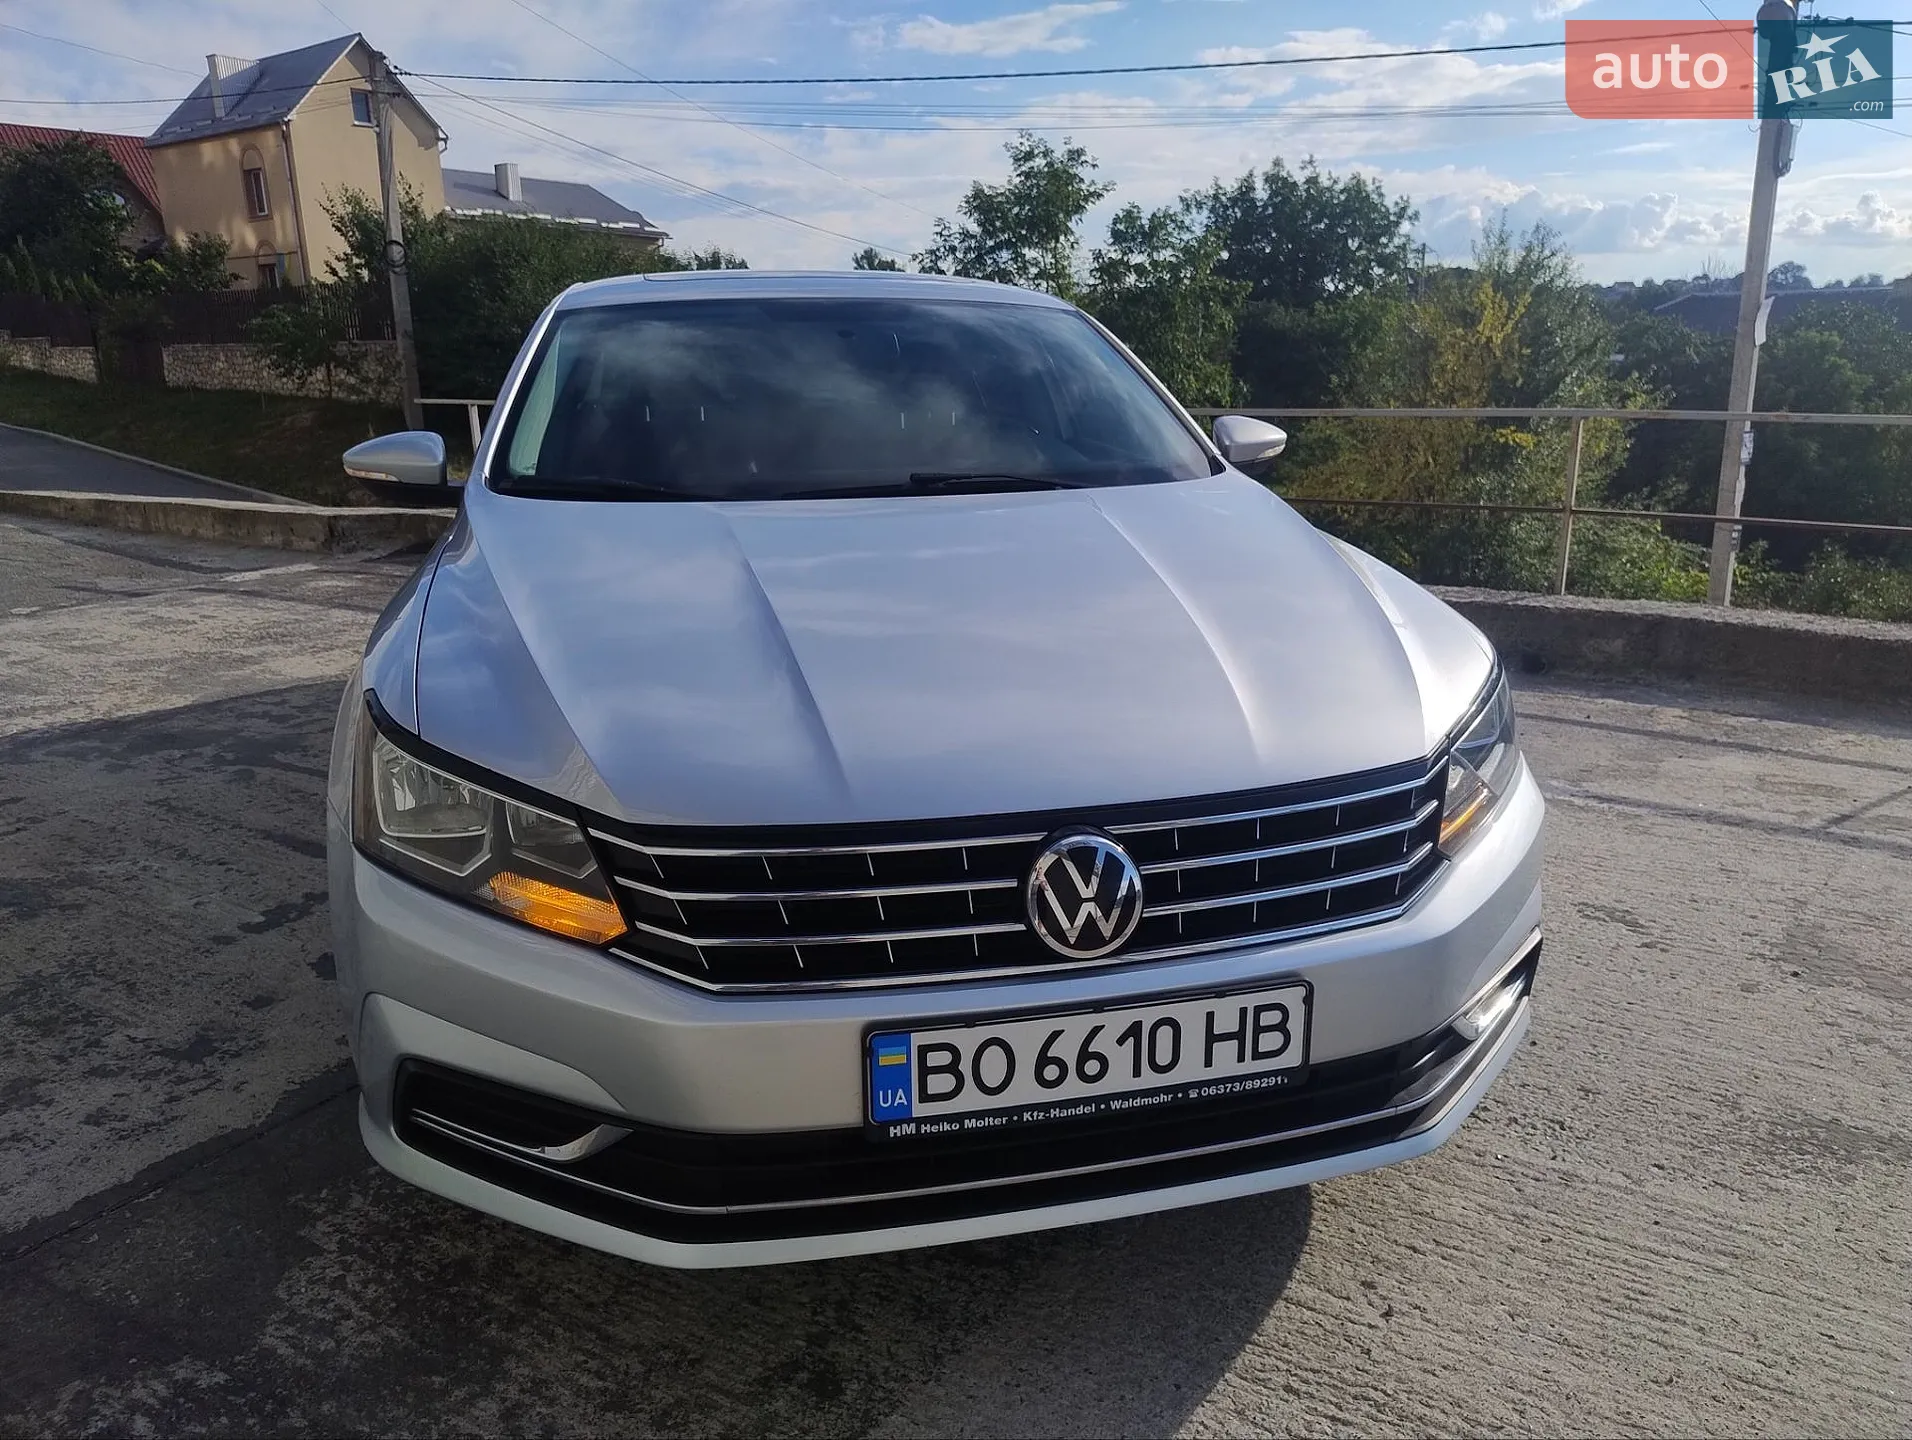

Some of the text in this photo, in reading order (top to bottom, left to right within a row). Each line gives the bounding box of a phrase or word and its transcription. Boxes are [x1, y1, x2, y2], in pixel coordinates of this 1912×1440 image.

[917, 1002, 1291, 1104] BO 6610 HB
[879, 1088, 908, 1108] UA
[889, 1122, 917, 1138] HM
[964, 1115, 1009, 1130] Molter
[1023, 1104, 1096, 1122] Kfz-Handel
[1110, 1092, 1174, 1111] Waldmohr
